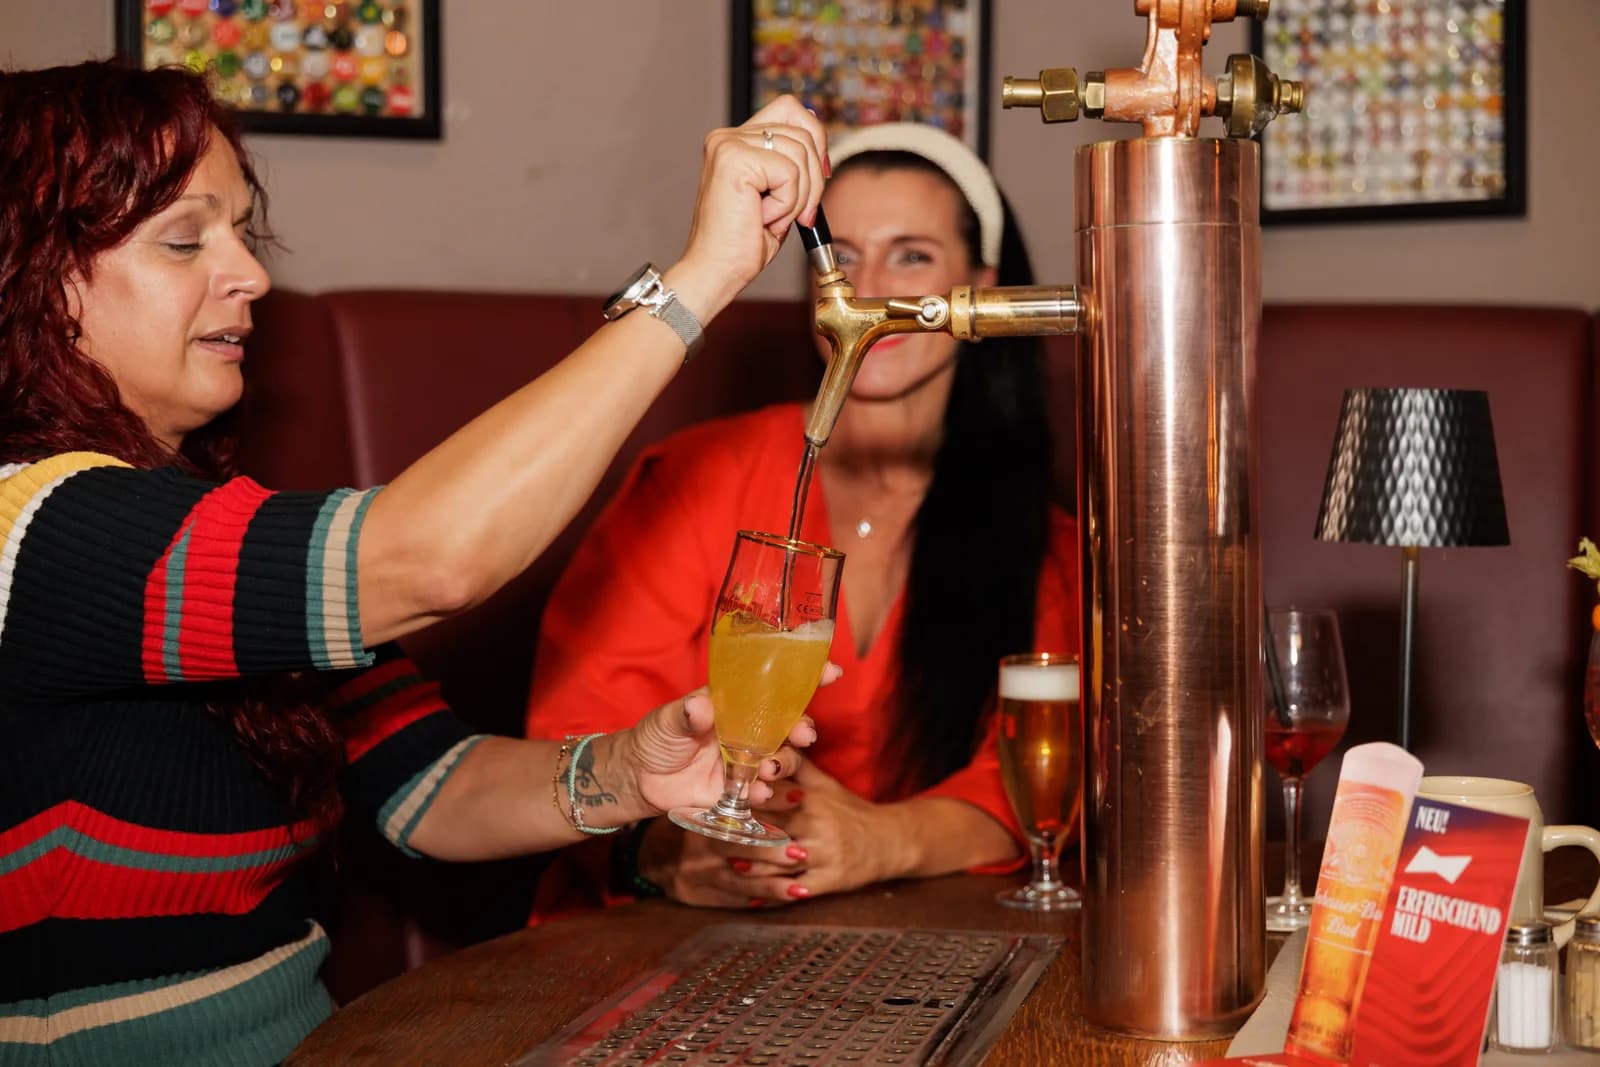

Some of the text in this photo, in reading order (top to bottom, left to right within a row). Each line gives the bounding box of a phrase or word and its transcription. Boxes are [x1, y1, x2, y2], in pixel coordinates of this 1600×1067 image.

[1415, 805, 1450, 833] NEU!
[1396, 886, 1501, 935] ERFRISCHEND
[1390, 911, 1432, 943] MILD
